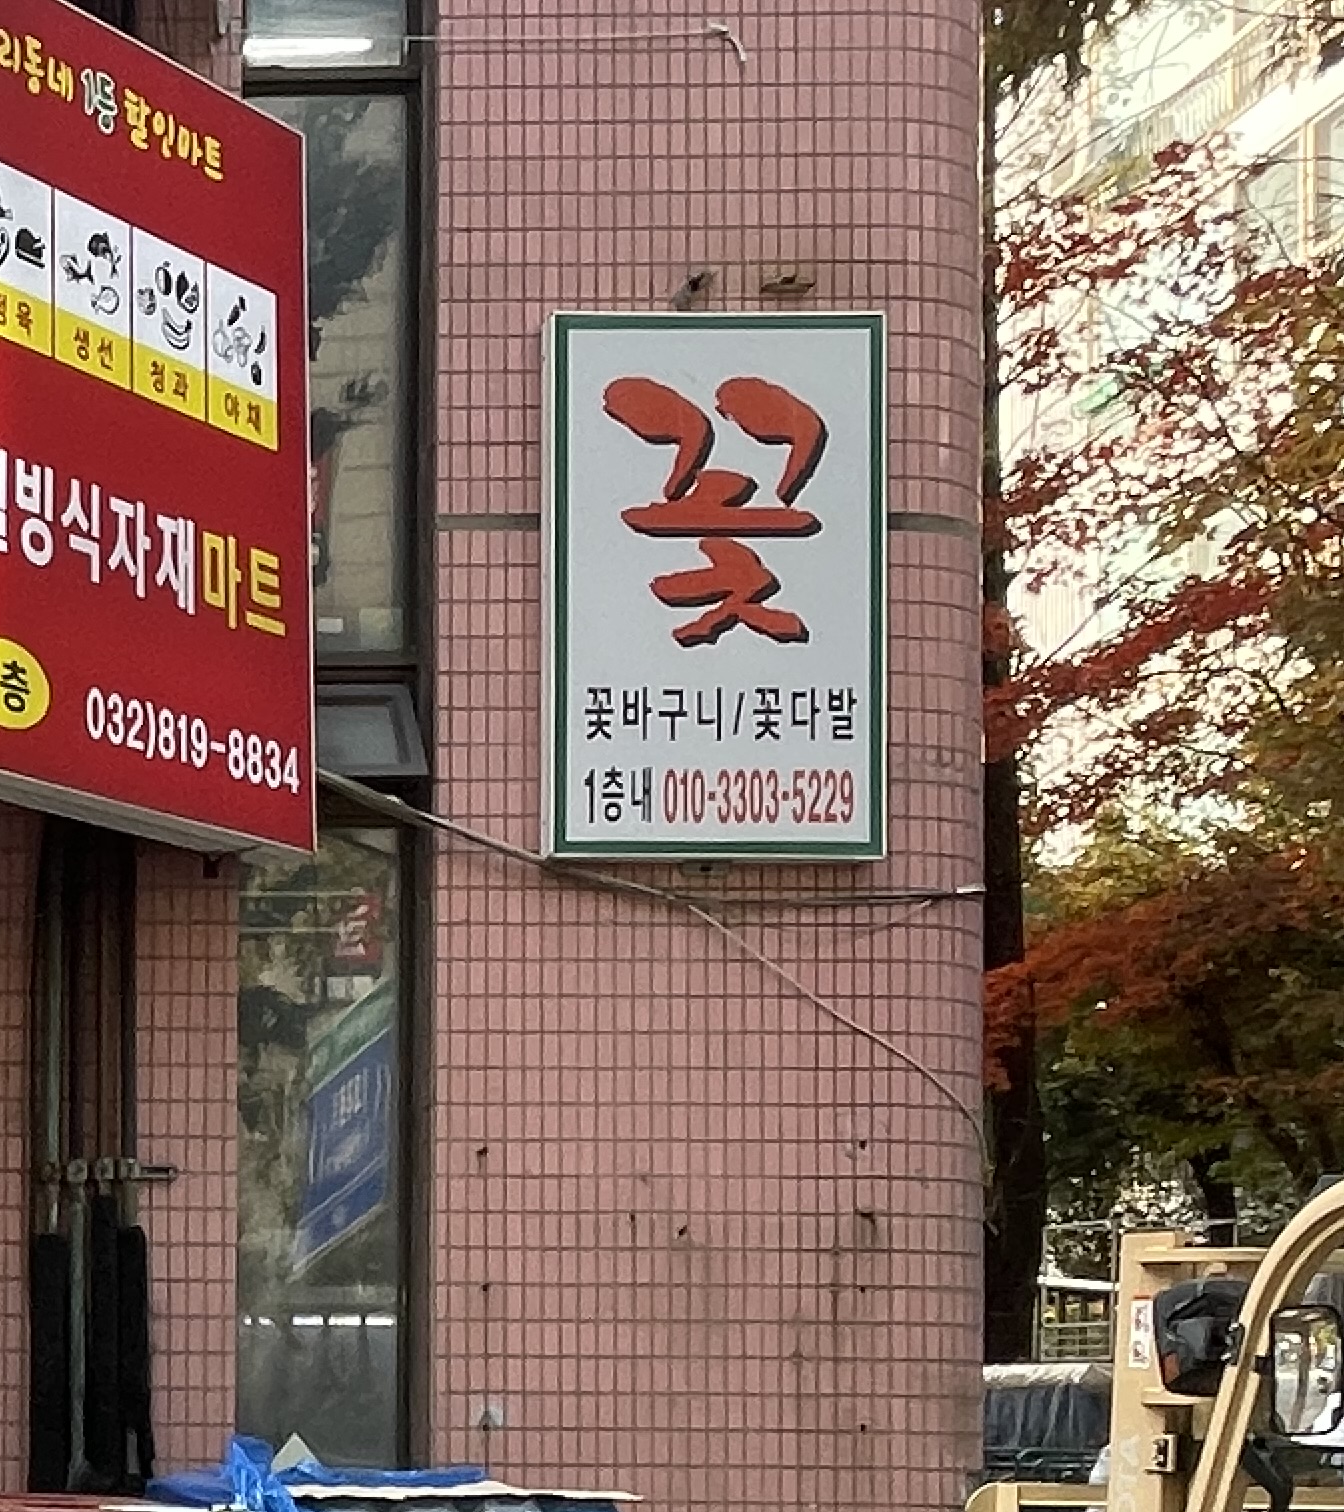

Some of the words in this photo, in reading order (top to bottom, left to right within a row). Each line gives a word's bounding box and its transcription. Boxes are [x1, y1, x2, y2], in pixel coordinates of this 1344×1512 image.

[79, 67, 119, 136] 1등
[123, 89, 224, 182] 할인마트
[72, 326, 115, 373] 생선
[150, 358, 190, 403] 청과
[223, 393, 263, 436] 야채
[602, 376, 829, 647] 꽃
[84, 685, 301, 795] 032)819-8834
[583, 685, 858, 743] 꽃바구니/꽃다발
[583, 765, 655, 824] 1층내
